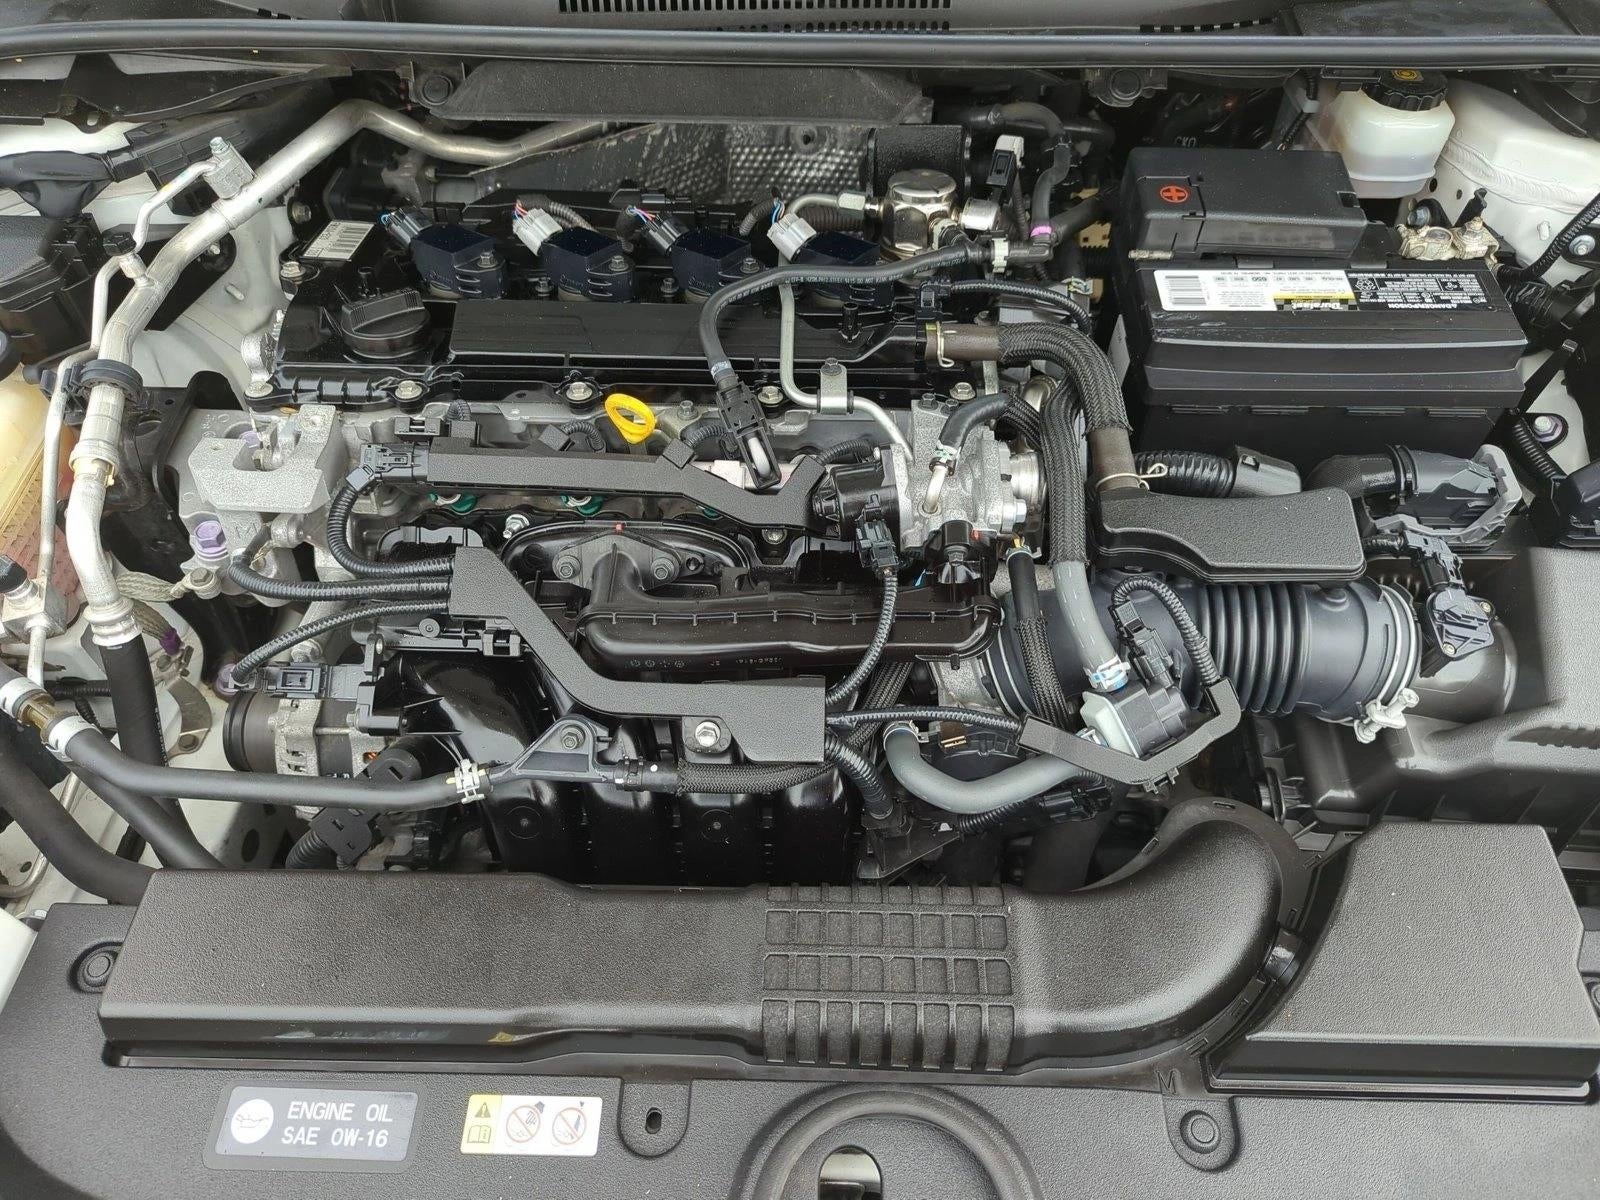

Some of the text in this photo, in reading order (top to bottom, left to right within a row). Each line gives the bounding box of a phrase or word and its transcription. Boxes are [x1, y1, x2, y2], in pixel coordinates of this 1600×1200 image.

[1291, 302, 1343, 310] Duralast
[1155, 1068, 1177, 1096] M
[287, 1101, 393, 1122] ENGINE OIL
[281, 1126, 389, 1147] SAE 0W-16
